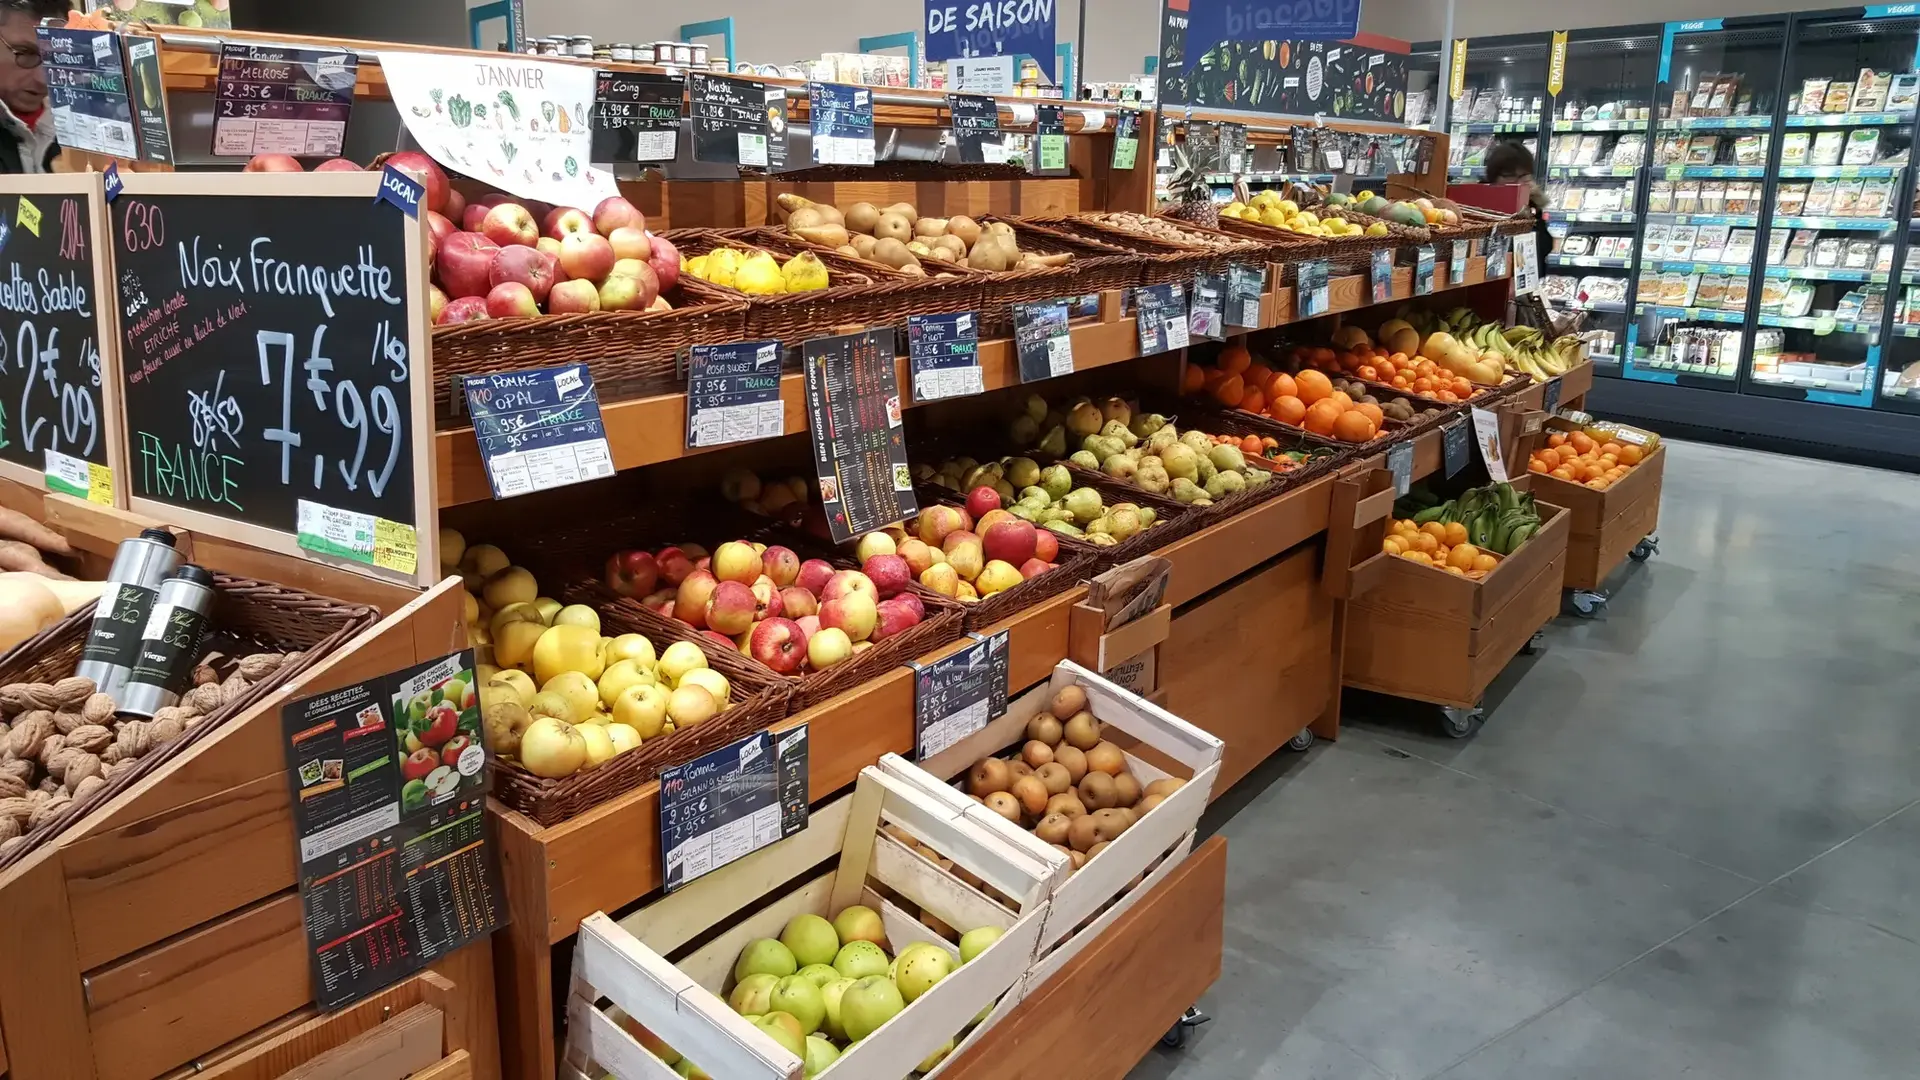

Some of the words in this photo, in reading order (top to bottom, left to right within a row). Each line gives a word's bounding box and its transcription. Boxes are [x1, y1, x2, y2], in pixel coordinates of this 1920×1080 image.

[929, 7, 957, 34] DE
[965, 0, 1050, 32] SAISON
[1887, 5, 1915, 14] VEGGIE
[1680, 22, 1704, 31] VEGGIE
[240, 67, 291, 79] MELROSE
[1551, 41, 1564, 87] TRAITEUR
[91, 73, 118, 91] FRANCE
[475, 64, 545, 89] JANVIER
[612, 81, 640, 100] Coing
[707, 80, 732, 94] Nashi
[384, 172, 418, 205] LOCAL
[124, 200, 166, 252] 630
[178, 236, 244, 293] Noix
[250, 237, 402, 317] Franquette
[39, 267, 91, 317] Sable
[143, 313, 180, 354] ETRICHÉ
[371, 319, 408, 382] /kg
[709, 347, 737, 361] Pomme
[757, 350, 774, 360] LOCAL
[951, 342, 975, 355] FRANCE
[1626, 341, 1634, 363] VEGGIE
[78, 337, 102, 386] /kg
[706, 364, 725, 375] ROSA
[491, 373, 541, 389] POMME
[556, 376, 579, 388] LOCAL
[808, 356, 818, 390] POMMES
[1864, 365, 1876, 390] VEGGIE
[495, 391, 546, 410] OPAL
[812, 391, 820, 406] SES
[539, 408, 586, 427] FRANCE
[814, 408, 824, 440] CHOISIR
[819, 442, 828, 463] BIEN
[137, 431, 244, 511] FRANCE
[94, 629, 115, 640] Vierge
[144, 651, 167, 662] Vierge
[412, 681, 426, 694] SES
[426, 666, 454, 687] POMMES
[413, 673, 427, 685] BIEN
[427, 662, 448, 677] CHOISIR
[309, 693, 329, 710] IDÉES
[330, 685, 364, 703] RECETTES
[304, 708, 311, 718] ET
[312, 701, 336, 716] CONSEILS
[740, 743, 760, 761] LOCAL
[683, 762, 718, 782] Pomme
[664, 778, 684, 797] 110
